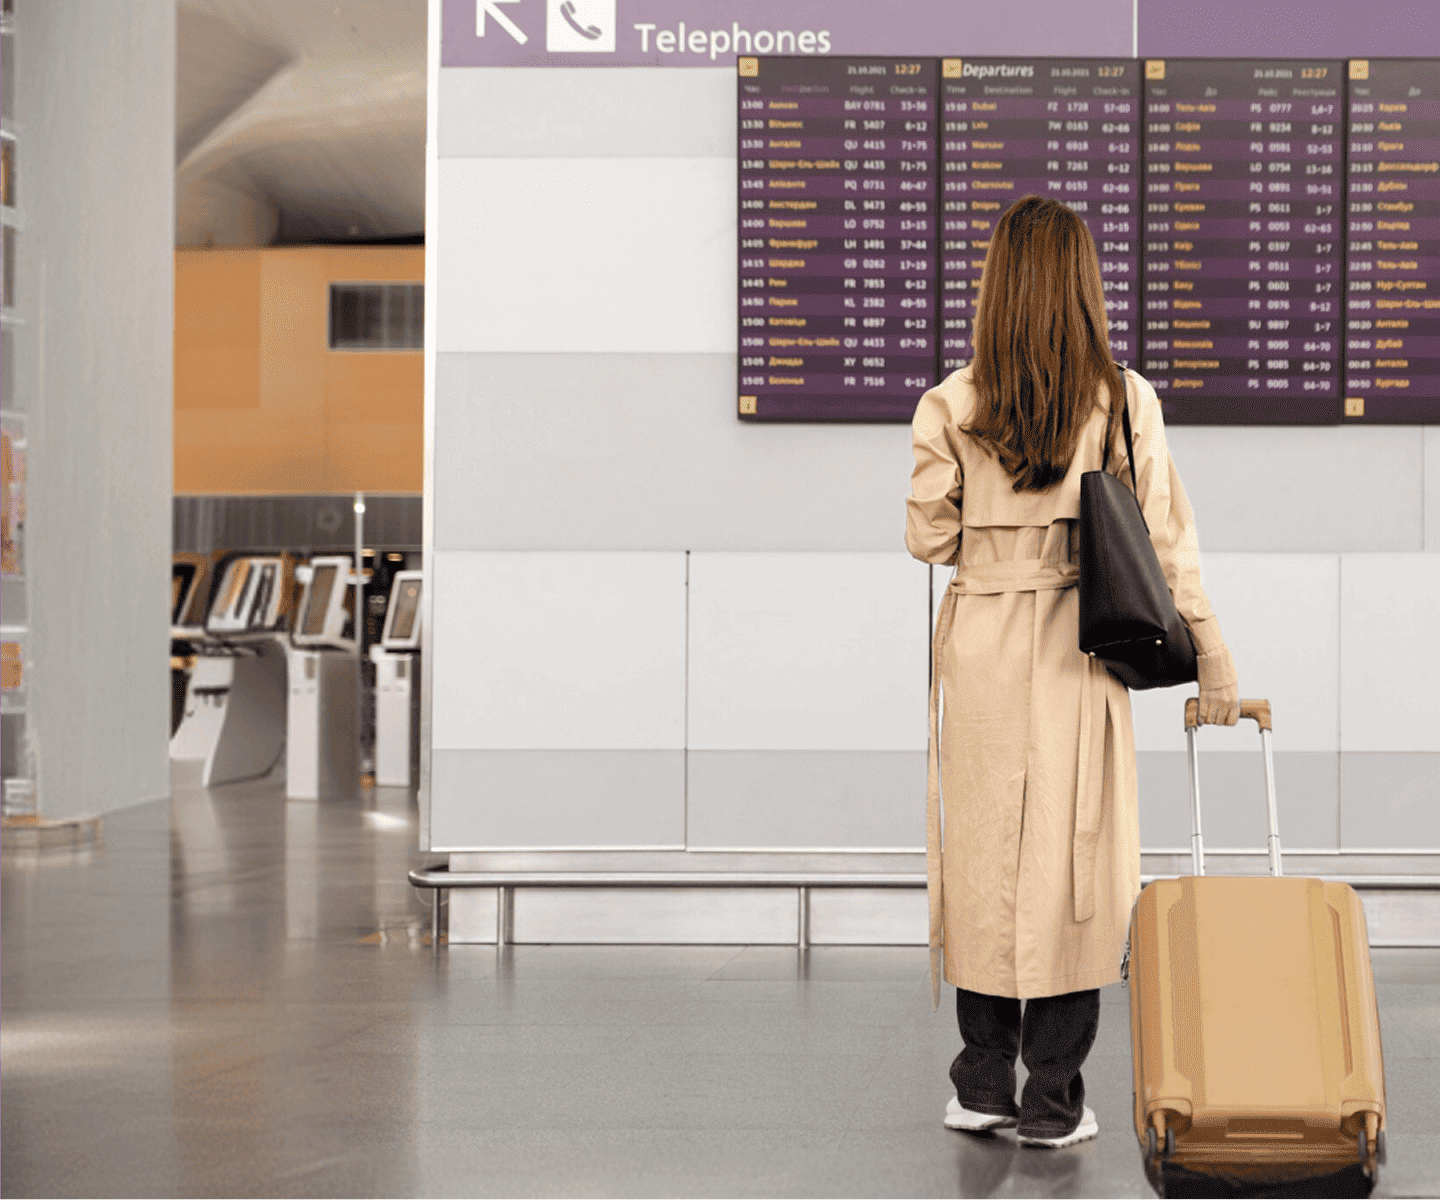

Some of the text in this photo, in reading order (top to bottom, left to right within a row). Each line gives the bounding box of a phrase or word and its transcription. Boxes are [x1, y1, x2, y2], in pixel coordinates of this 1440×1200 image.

[634, 22, 831, 60] Telephones
[894, 63, 922, 76] 12:27
[962, 64, 1034, 79] Departures
[1097, 65, 1125, 78] 12:27
[1300, 67, 1328, 79] 12:27
[849, 85, 927, 96] Flight Check-in
[946, 85, 1130, 97] Time Destination Flight Check-in
